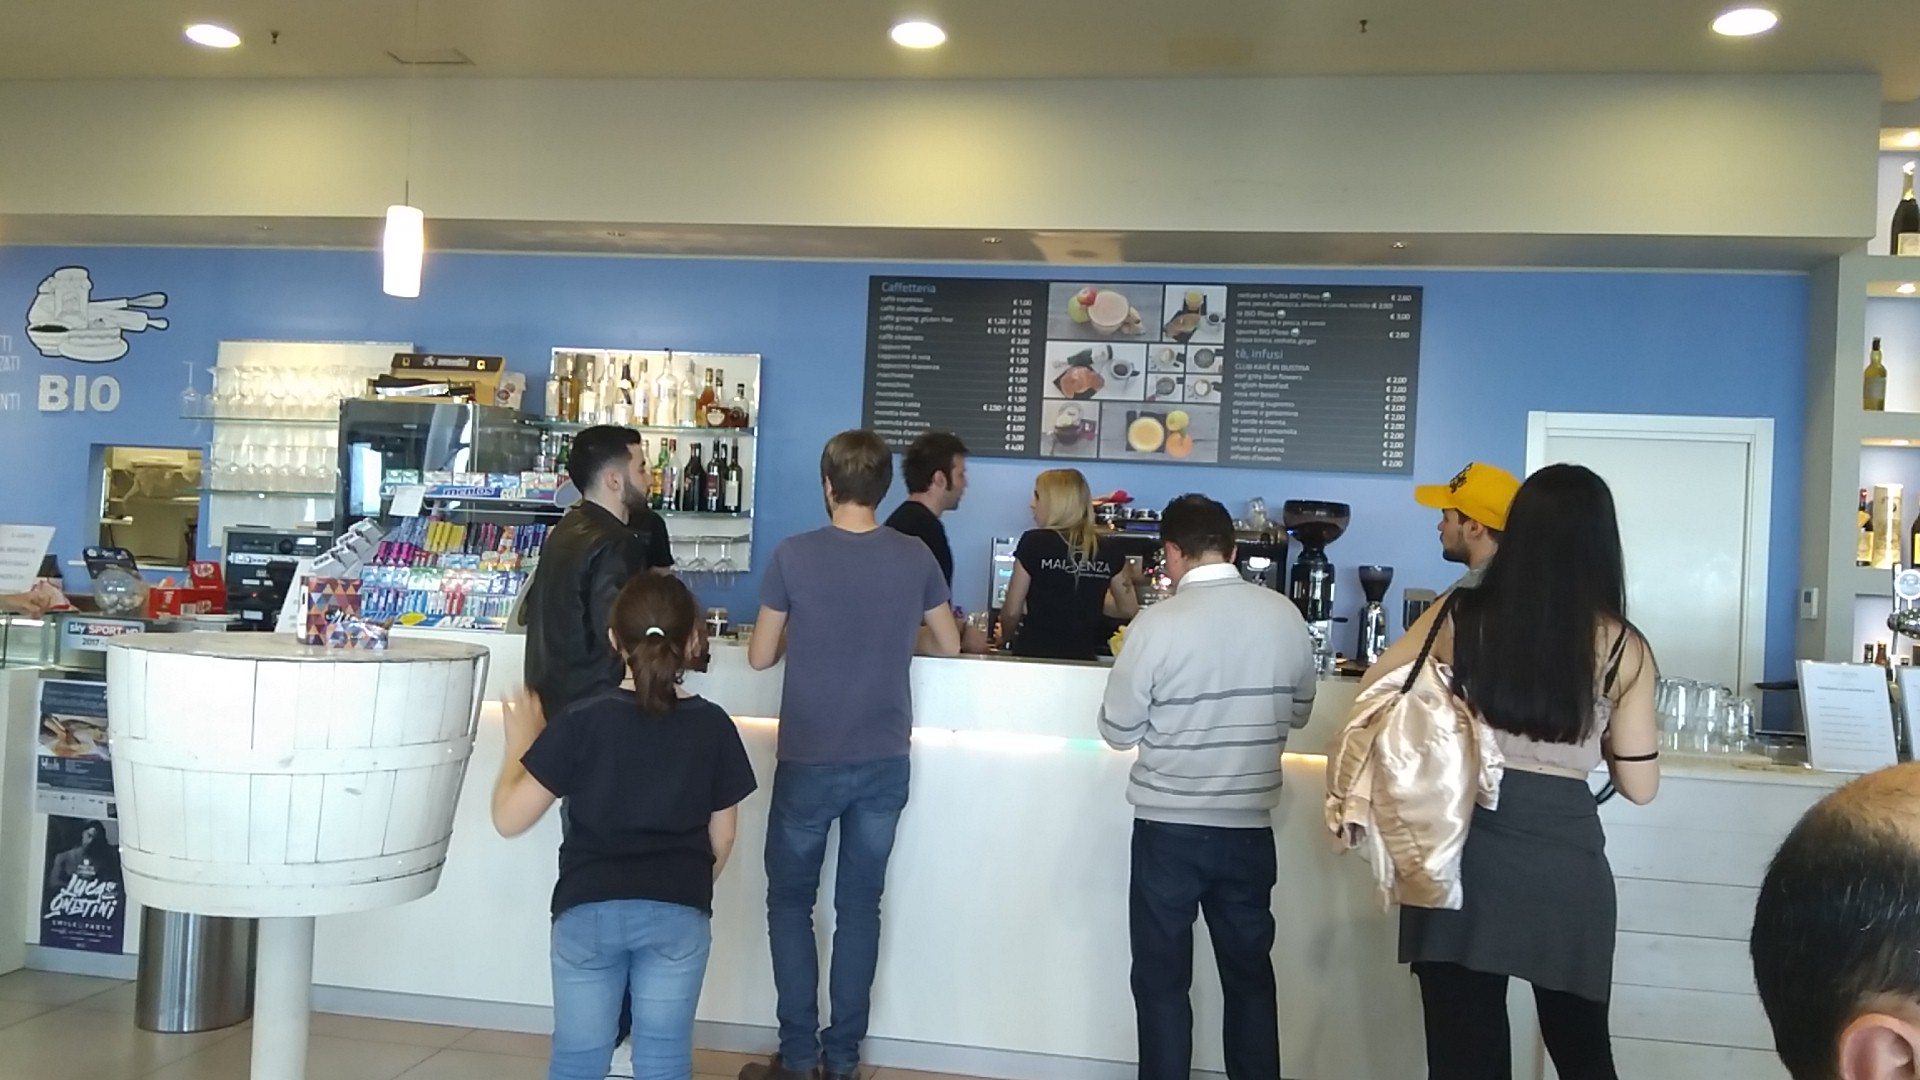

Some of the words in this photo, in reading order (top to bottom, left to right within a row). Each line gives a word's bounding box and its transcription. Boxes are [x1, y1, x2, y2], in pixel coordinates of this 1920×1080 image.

[1251, 349, 1283, 360] infusi
[38, 375, 120, 411] BIO
[444, 486, 495, 497] mentos
[69, 622, 86, 634] sky
[88, 624, 122, 635] SPORT
